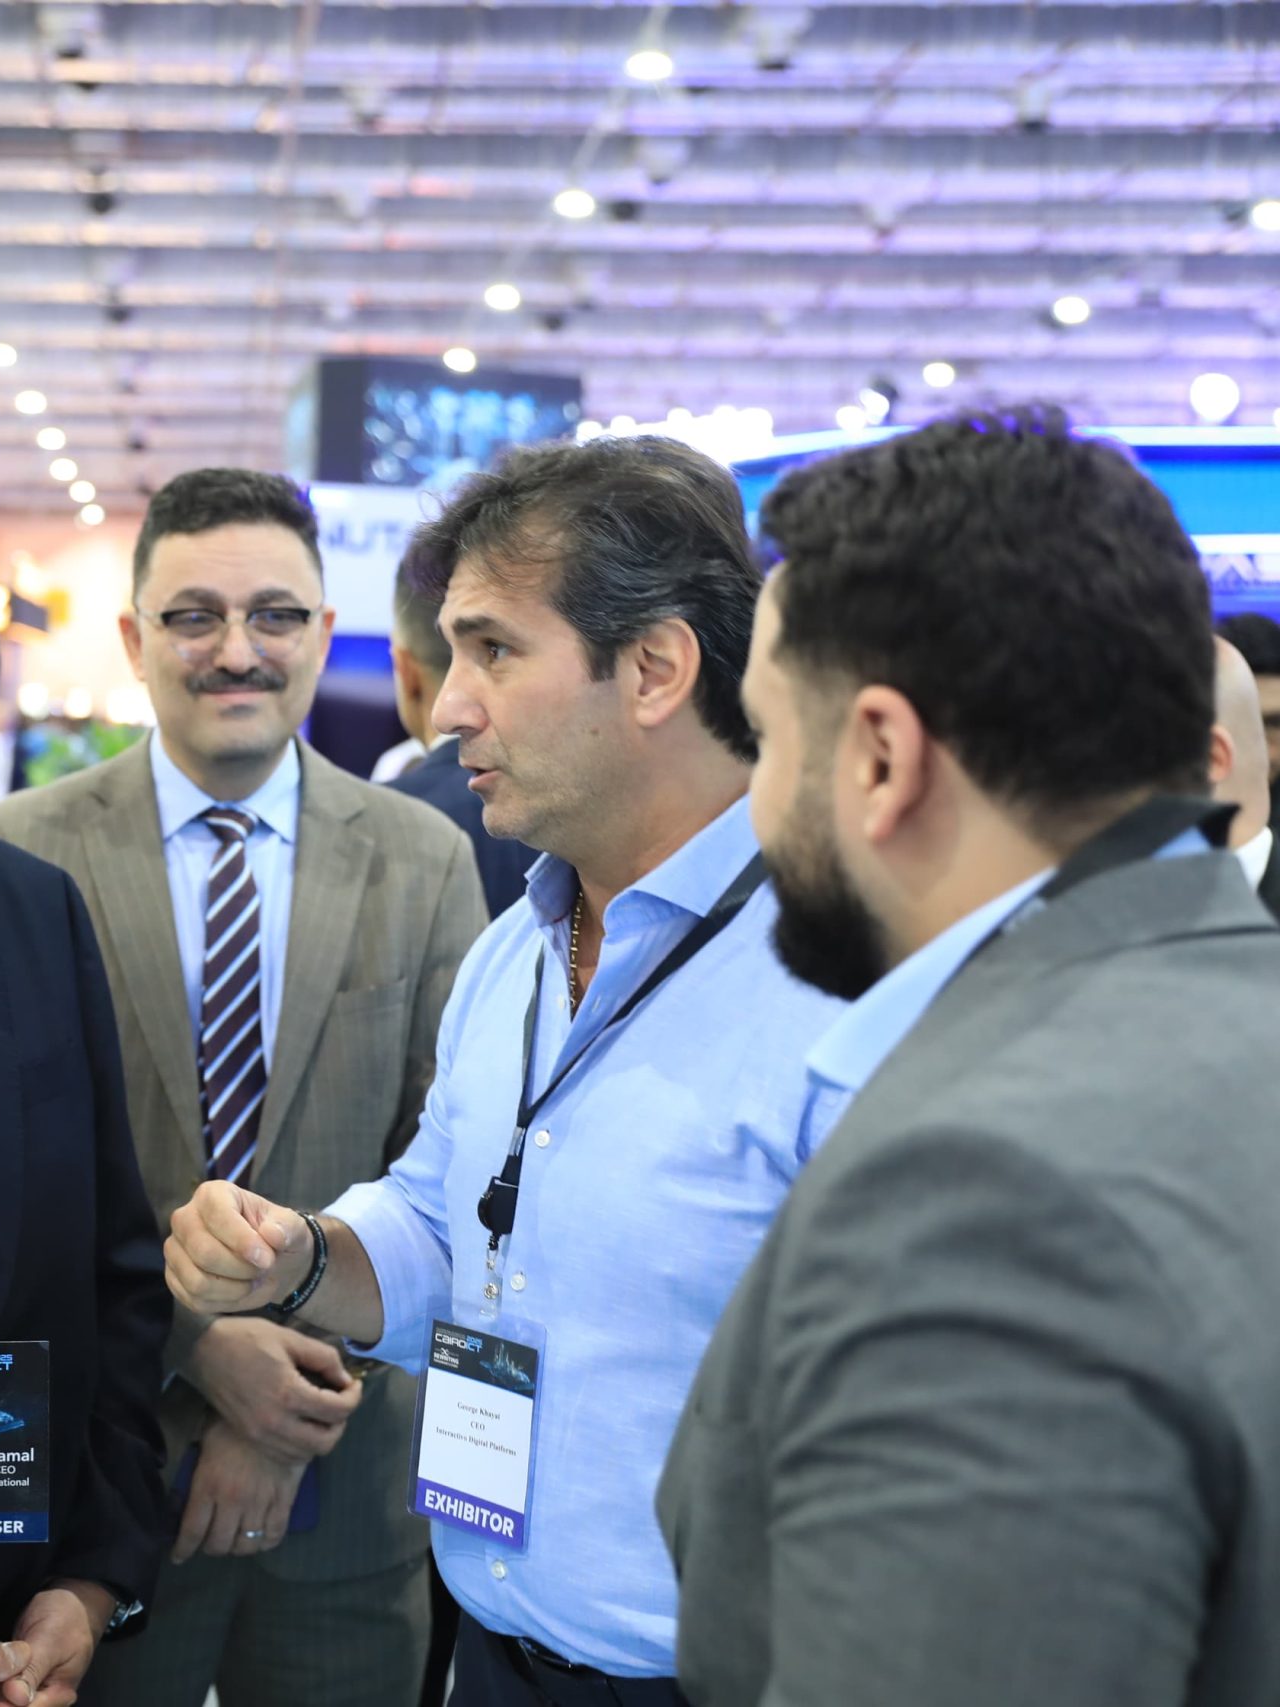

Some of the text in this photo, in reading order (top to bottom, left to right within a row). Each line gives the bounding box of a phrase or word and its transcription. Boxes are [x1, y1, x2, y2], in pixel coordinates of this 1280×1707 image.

[436, 1426, 468, 1442] Interactive
[468, 1435, 489, 1448] Digital
[470, 1421, 486, 1431] CEO
[425, 1489, 514, 1538] EXHIBITOR
